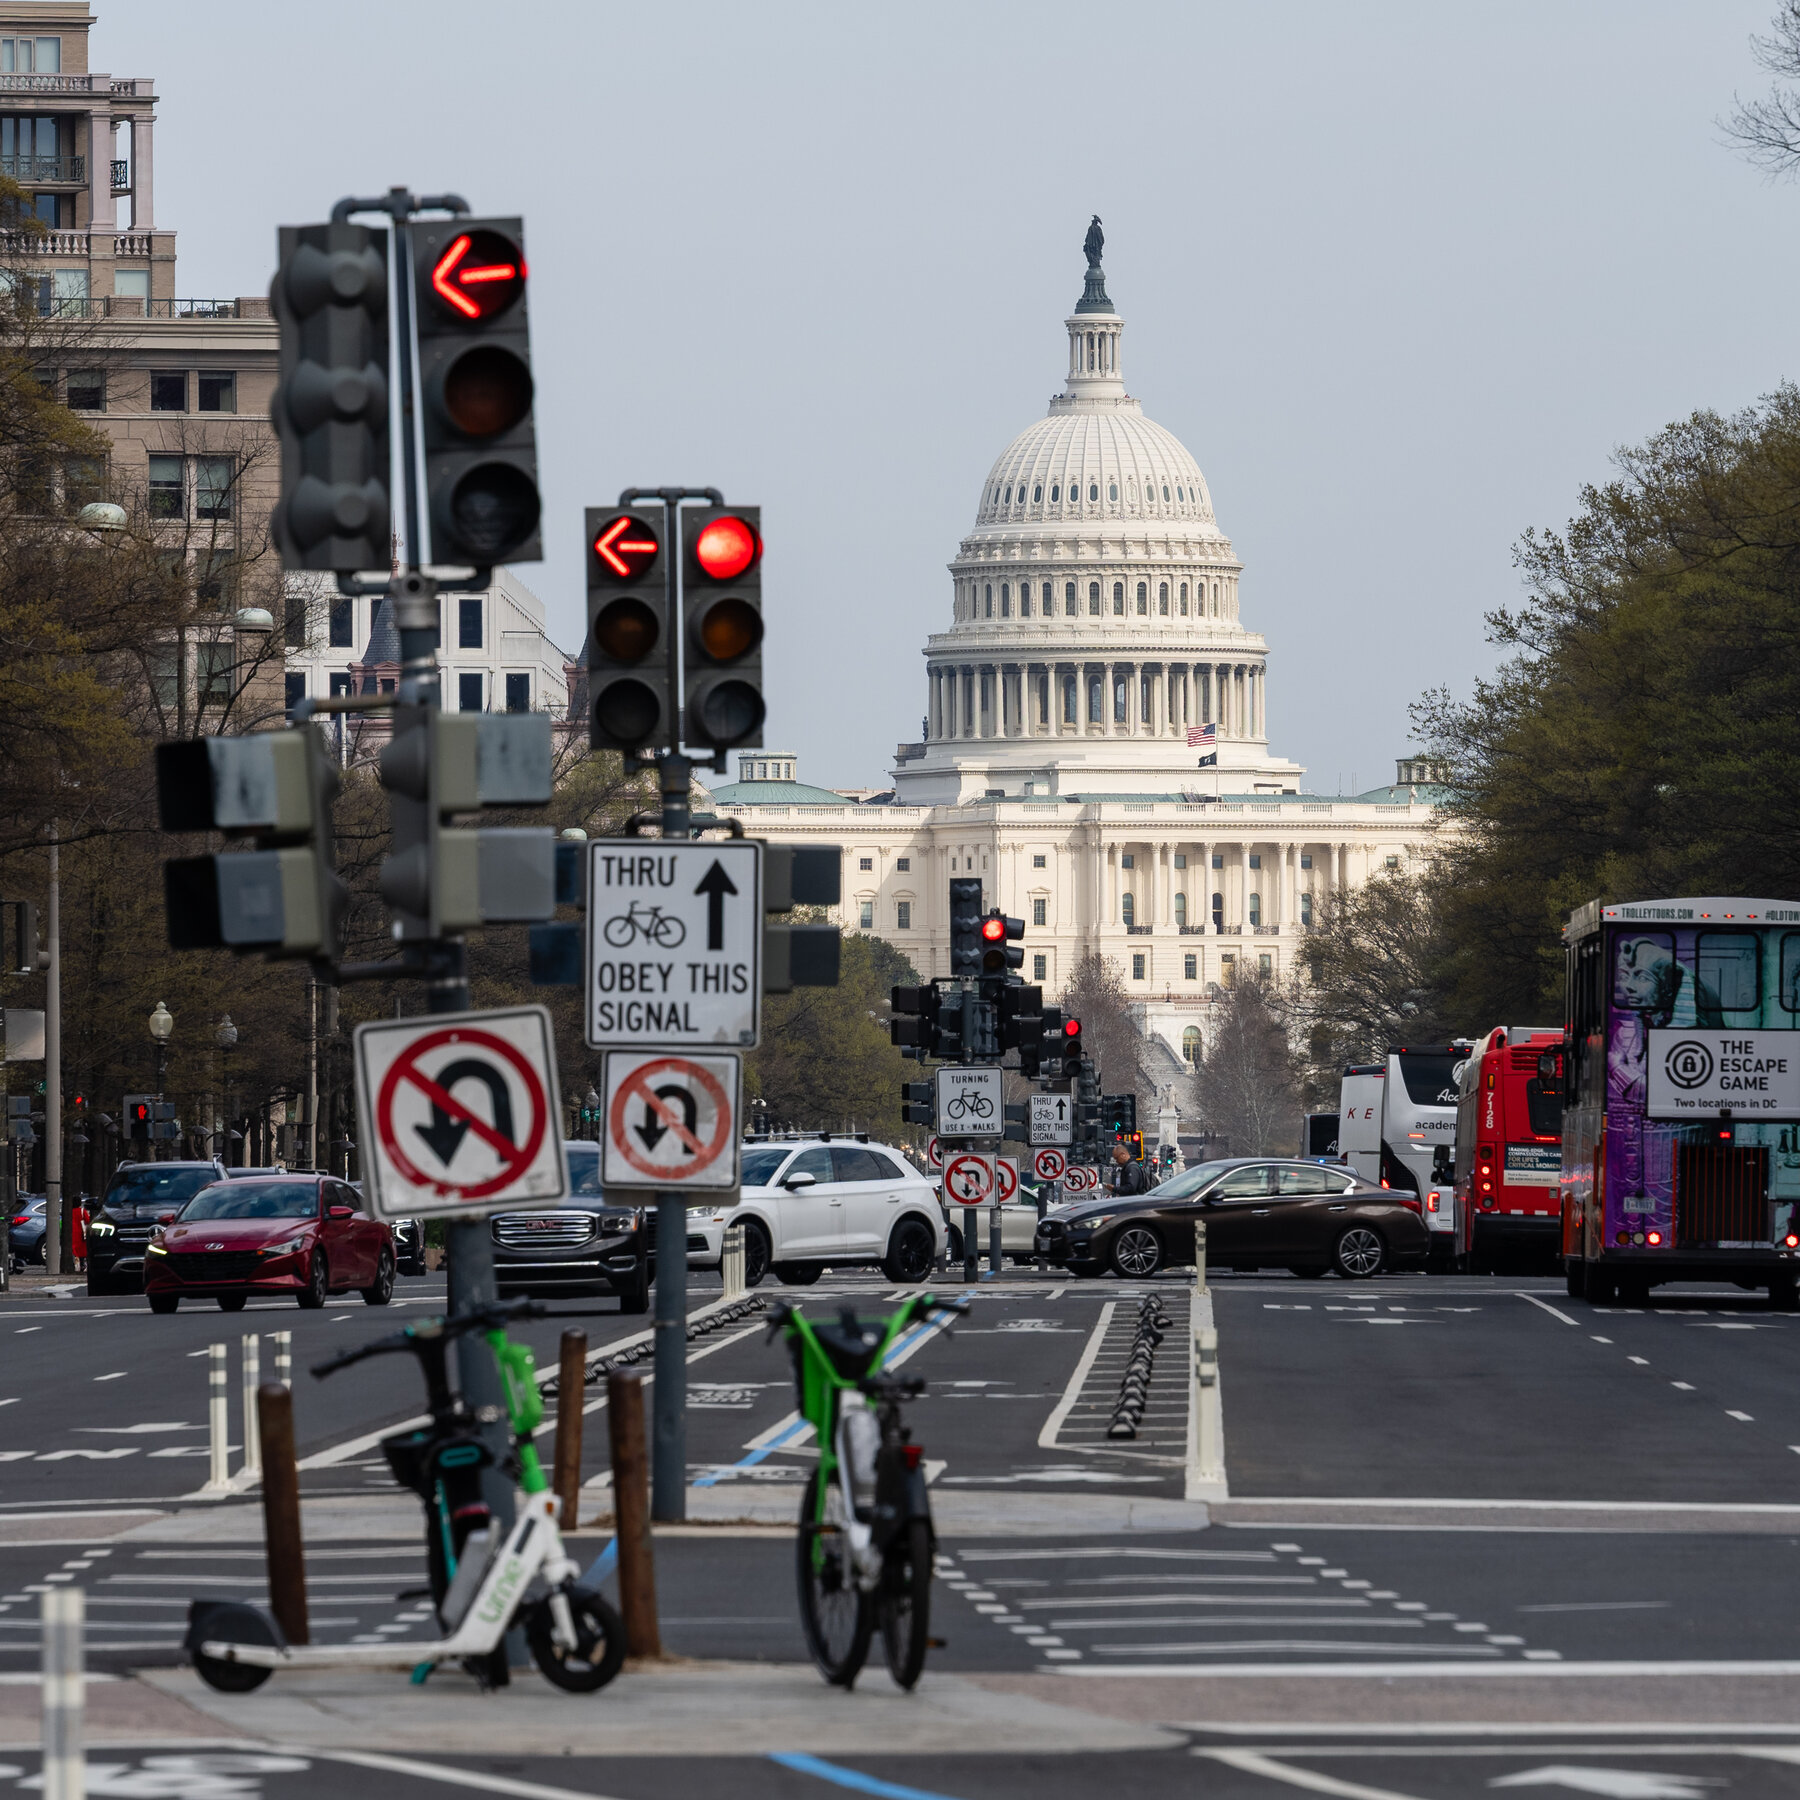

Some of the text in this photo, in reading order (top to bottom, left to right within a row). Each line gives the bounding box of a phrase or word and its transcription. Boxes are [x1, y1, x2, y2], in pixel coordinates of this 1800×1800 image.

[601, 856, 676, 887] THRU
[1622, 908, 1694, 920] TROLLEYTOURS.COM
[598, 962, 748, 993] OBEY THIS
[598, 1002, 699, 1032] SIGNAL
[1720, 1040, 1754, 1054] THE
[1720, 1058, 1788, 1073] ESCAPE
[951, 1075, 989, 1084] TURNING
[1720, 1076, 1769, 1091] GAME
[1033, 1097, 1051, 1105] THRU
[1674, 1098, 1778, 1108] Two locations in DC
[1033, 1123, 1069, 1131] OBEY THIS
[1033, 1133, 1058, 1141] SIGNAL
[526, 1220, 563, 1229] GMC
